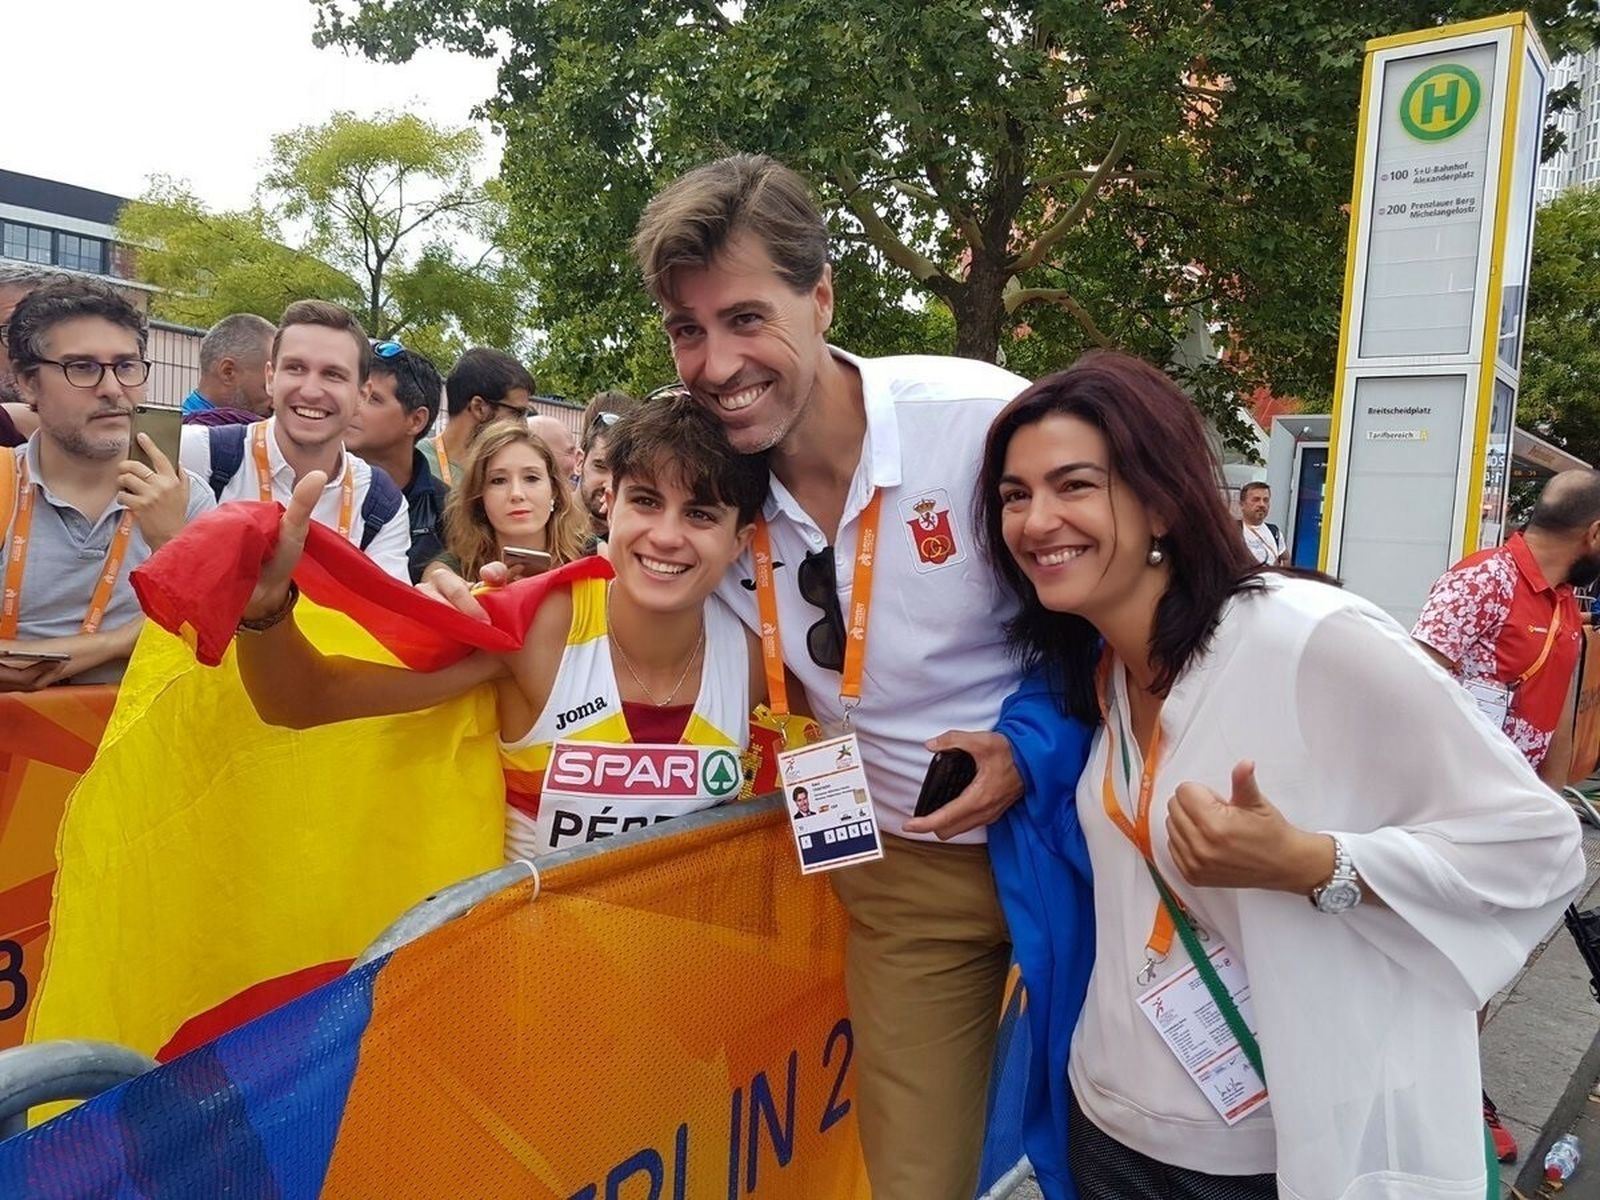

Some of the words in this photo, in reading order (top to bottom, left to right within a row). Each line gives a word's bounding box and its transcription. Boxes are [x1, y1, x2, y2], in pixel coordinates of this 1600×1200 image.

[1421, 80, 1459, 124] H
[1390, 170, 1409, 181] 100
[1413, 171, 1475, 184] Alexanderplatz
[1386, 204, 1407, 215] 200
[1411, 199, 1453, 210] Prenzlauer
[1456, 197, 1476, 207] Berg
[1410, 206, 1478, 219] Michelangelostr.
[1368, 406, 1432, 415] Breitscheidplatz
[1368, 431, 1414, 439] Tarifbereich
[554, 751, 695, 788] SPAR
[549, 806, 678, 848] PÉ
[567, 1050, 797, 1200] LIN
